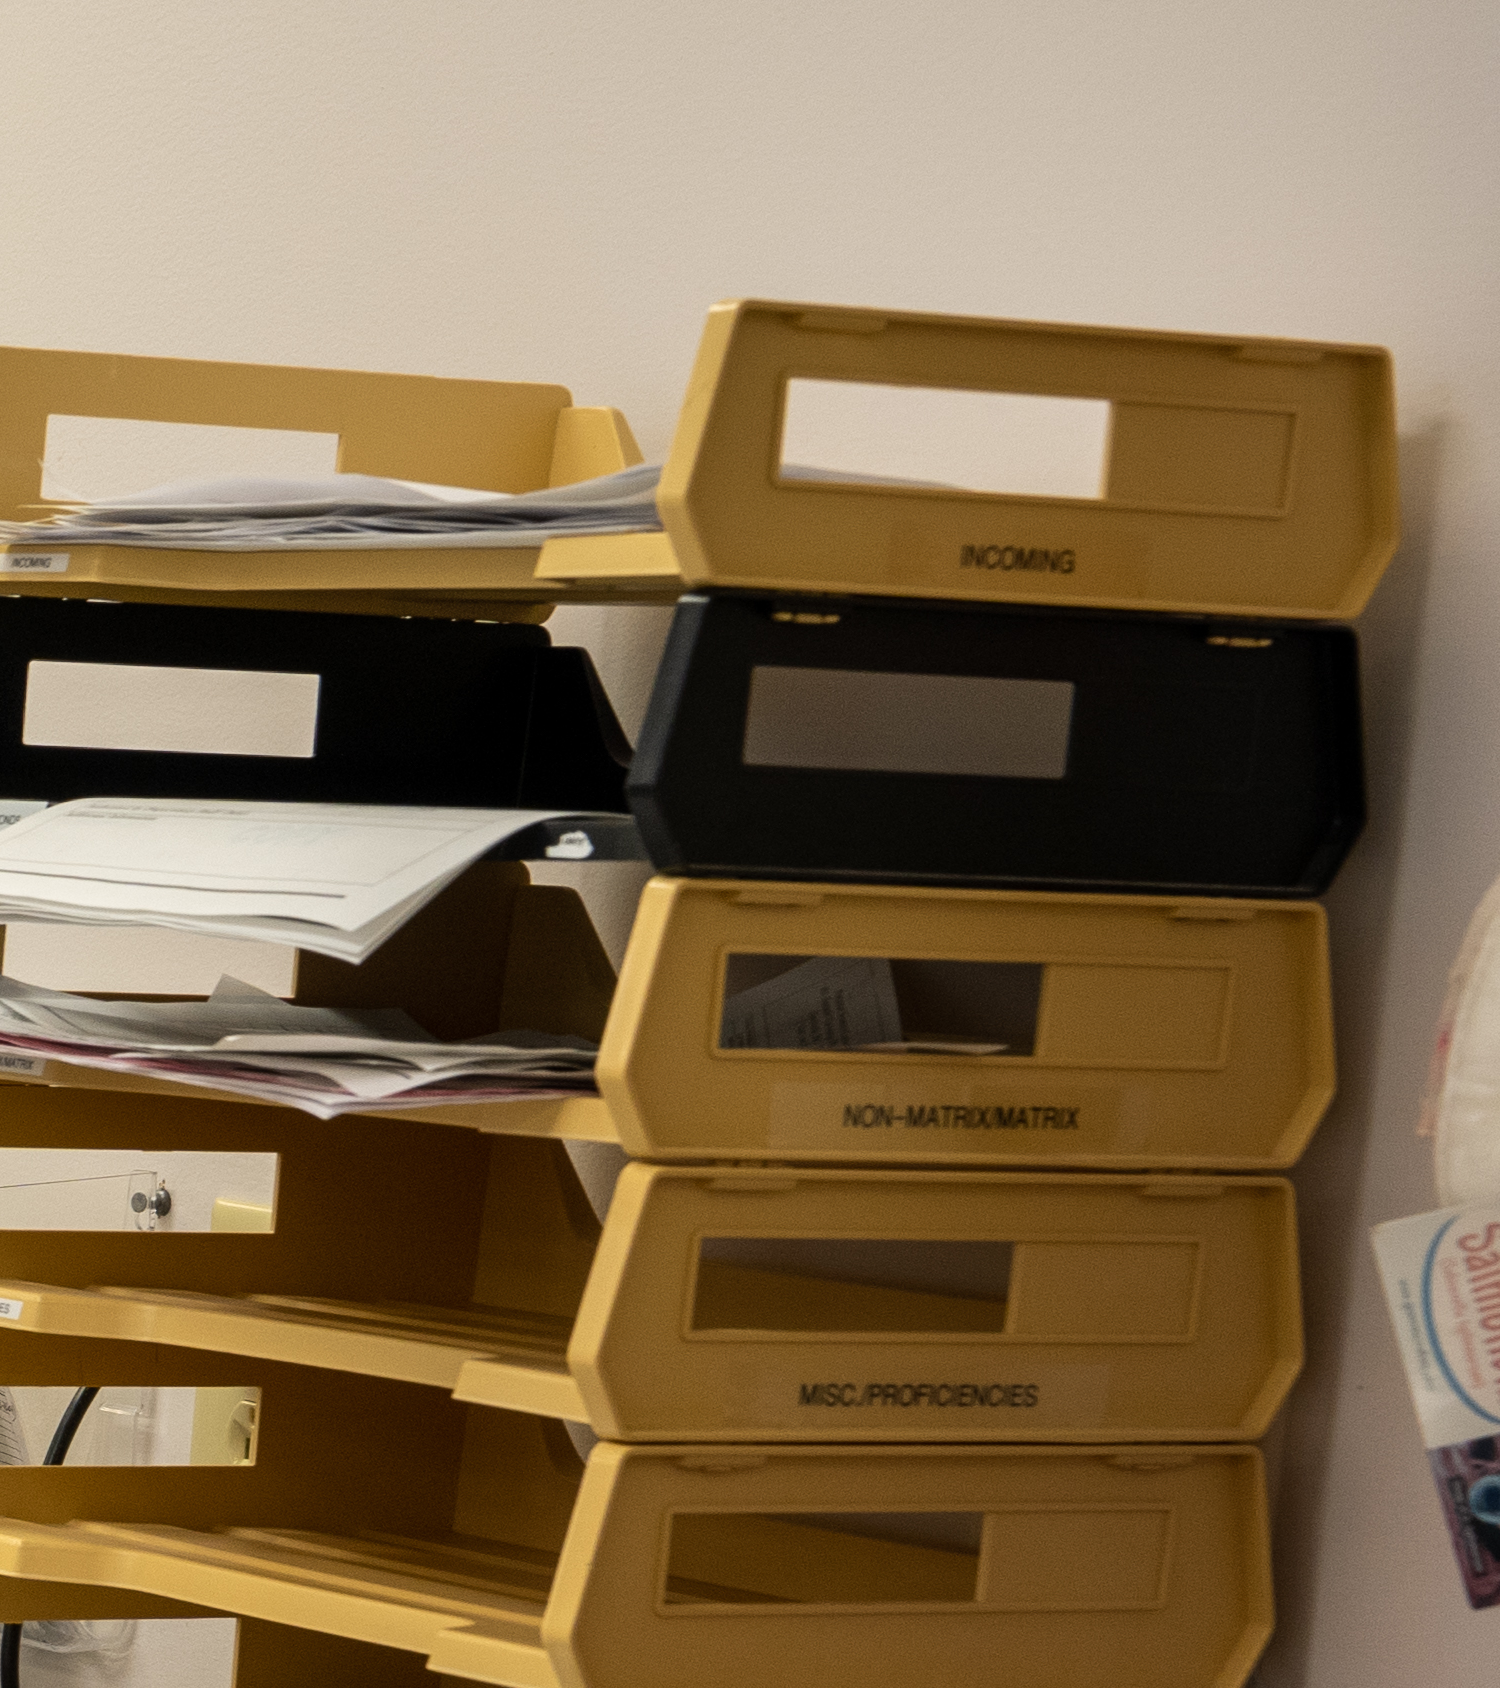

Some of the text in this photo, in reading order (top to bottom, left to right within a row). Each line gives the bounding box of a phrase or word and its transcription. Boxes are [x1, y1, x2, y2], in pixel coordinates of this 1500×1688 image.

[10, 557, 52, 568] INCOMING
[959, 544, 1077, 575] INCOMING
[843, 1104, 1080, 1131] NON-MATRIX/MATRIX
[797, 1381, 1040, 1409] MISC./PROFICIENCIES
